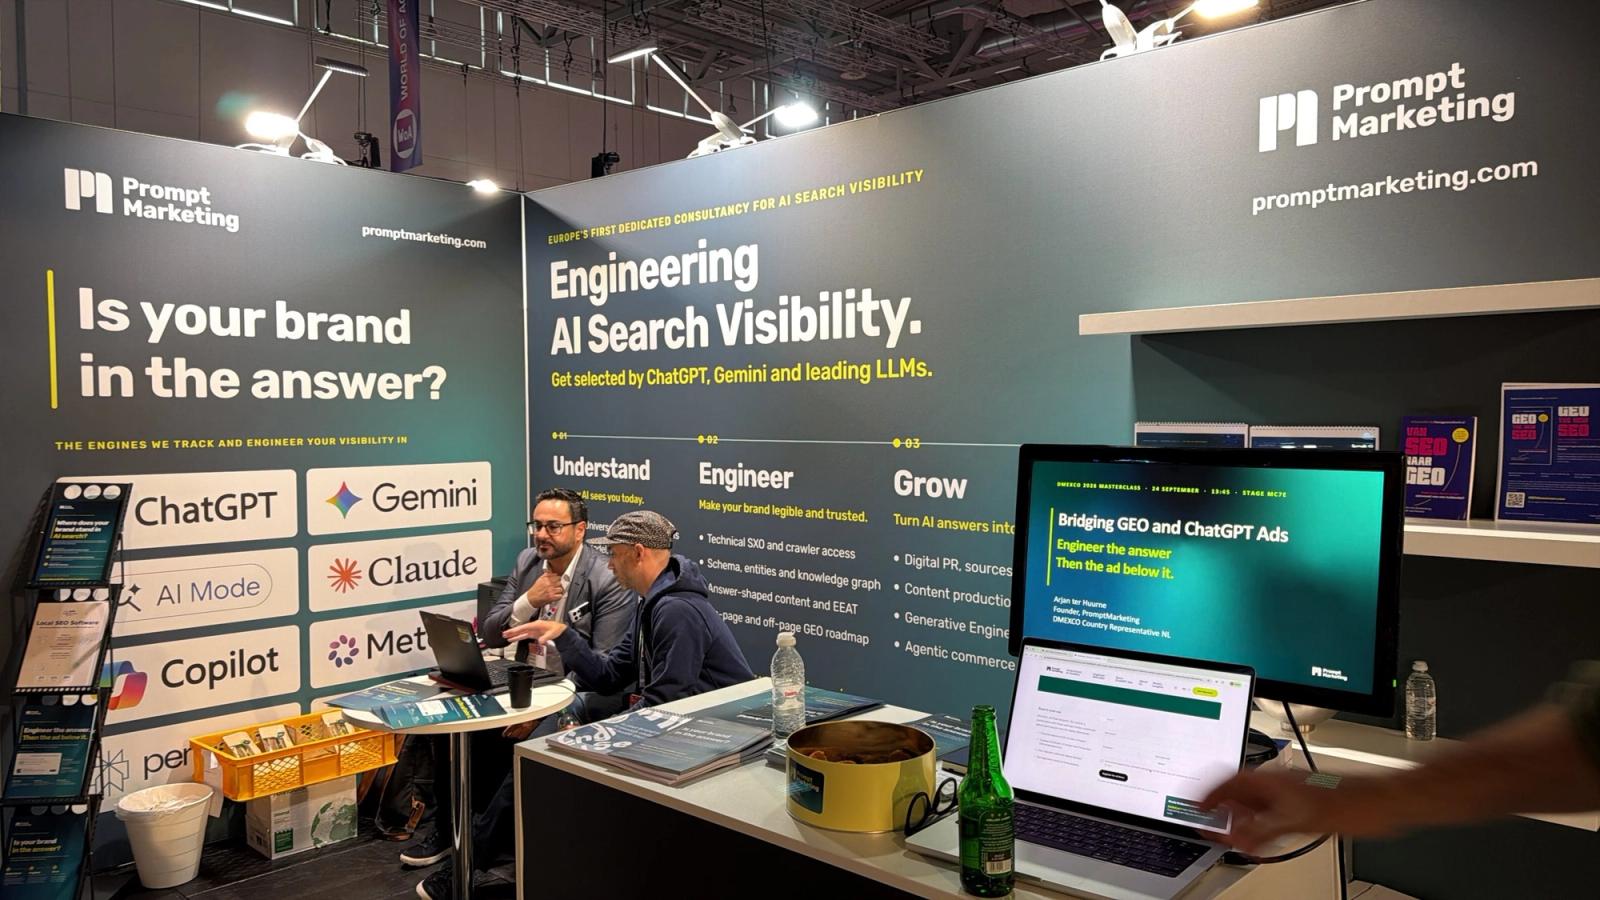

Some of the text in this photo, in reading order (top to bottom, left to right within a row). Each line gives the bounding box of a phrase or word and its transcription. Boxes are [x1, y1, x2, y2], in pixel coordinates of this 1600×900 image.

[400, 19, 408, 38] OF
[400, 44, 408, 100] WORLD
[1332, 62, 1465, 111] Prompt
[1332, 92, 1515, 142] Marketing
[398, 127, 413, 142] WoA
[123, 176, 210, 204] Prompt
[1252, 160, 1538, 216] promptmarketing.com
[124, 200, 240, 232] Marketing
[548, 169, 924, 244] EUROPE'S FIRST DEDICATED CONSULTANCY FOR AI SEARCH VISIBILITY
[362, 225, 486, 249] promptmarketing.com
[551, 238, 759, 306] Engineering
[79, 288, 411, 344] Is your brand
[551, 288, 922, 355] AI Search Visibility.
[80, 354, 448, 401] in the answer?
[552, 357, 932, 389] Get selected by ChatGPT, Gemini and leading LLMs.
[55, 436, 408, 450] THE ENGINES WE TRACK AND ENGINEER YOUR VISIBILITY IN
[707, 435, 718, 444] 02
[905, 438, 920, 448] 03
[1405, 436, 1448, 456] SEO
[552, 455, 650, 480] Understand
[699, 462, 794, 492] Engineer
[1406, 466, 1446, 486] GEO
[372, 479, 478, 512] Gemini
[582, 490, 589, 500] AI
[608, 494, 620, 503] you
[622, 493, 644, 506] today.
[894, 470, 968, 500] Grow
[135, 491, 278, 527] ChatGPT
[699, 500, 868, 522] Make your brand legible and trusted.
[893, 513, 919, 526] Turn
[922, 516, 934, 527] AI
[937, 518, 989, 532] answers
[1058, 512, 1289, 543] Bridging GEO and ChatGPT Ads
[707, 533, 856, 560] Technical SXO and crawler access
[1057, 538, 1172, 560] Engineer the answer
[368, 549, 478, 587] Claude
[707, 558, 881, 592] Schema, entities and knowledge graph
[904, 554, 939, 570] Digital
[965, 562, 1013, 577] sources
[1056, 556, 1174, 580] Then the ad below it.
[156, 578, 260, 606] AI Mode
[708, 582, 858, 614] Answer-shaped content and EEAT
[904, 582, 1011, 608] Content productio
[1054, 596, 1070, 604] Arjan
[1082, 600, 1107, 608] Huurne
[715, 610, 870, 646] -page and off-page GEO roadmap
[904, 612, 966, 632] Generative
[1052, 616, 1172, 638] DMEXCO Country Representative NL
[1053, 606, 1140, 625] Founder, PromptMarketing
[367, 627, 430, 659] Met
[905, 641, 1016, 671] Agentic commerce
[161, 647, 279, 690] Copilot
[144, 748, 192, 780] per
